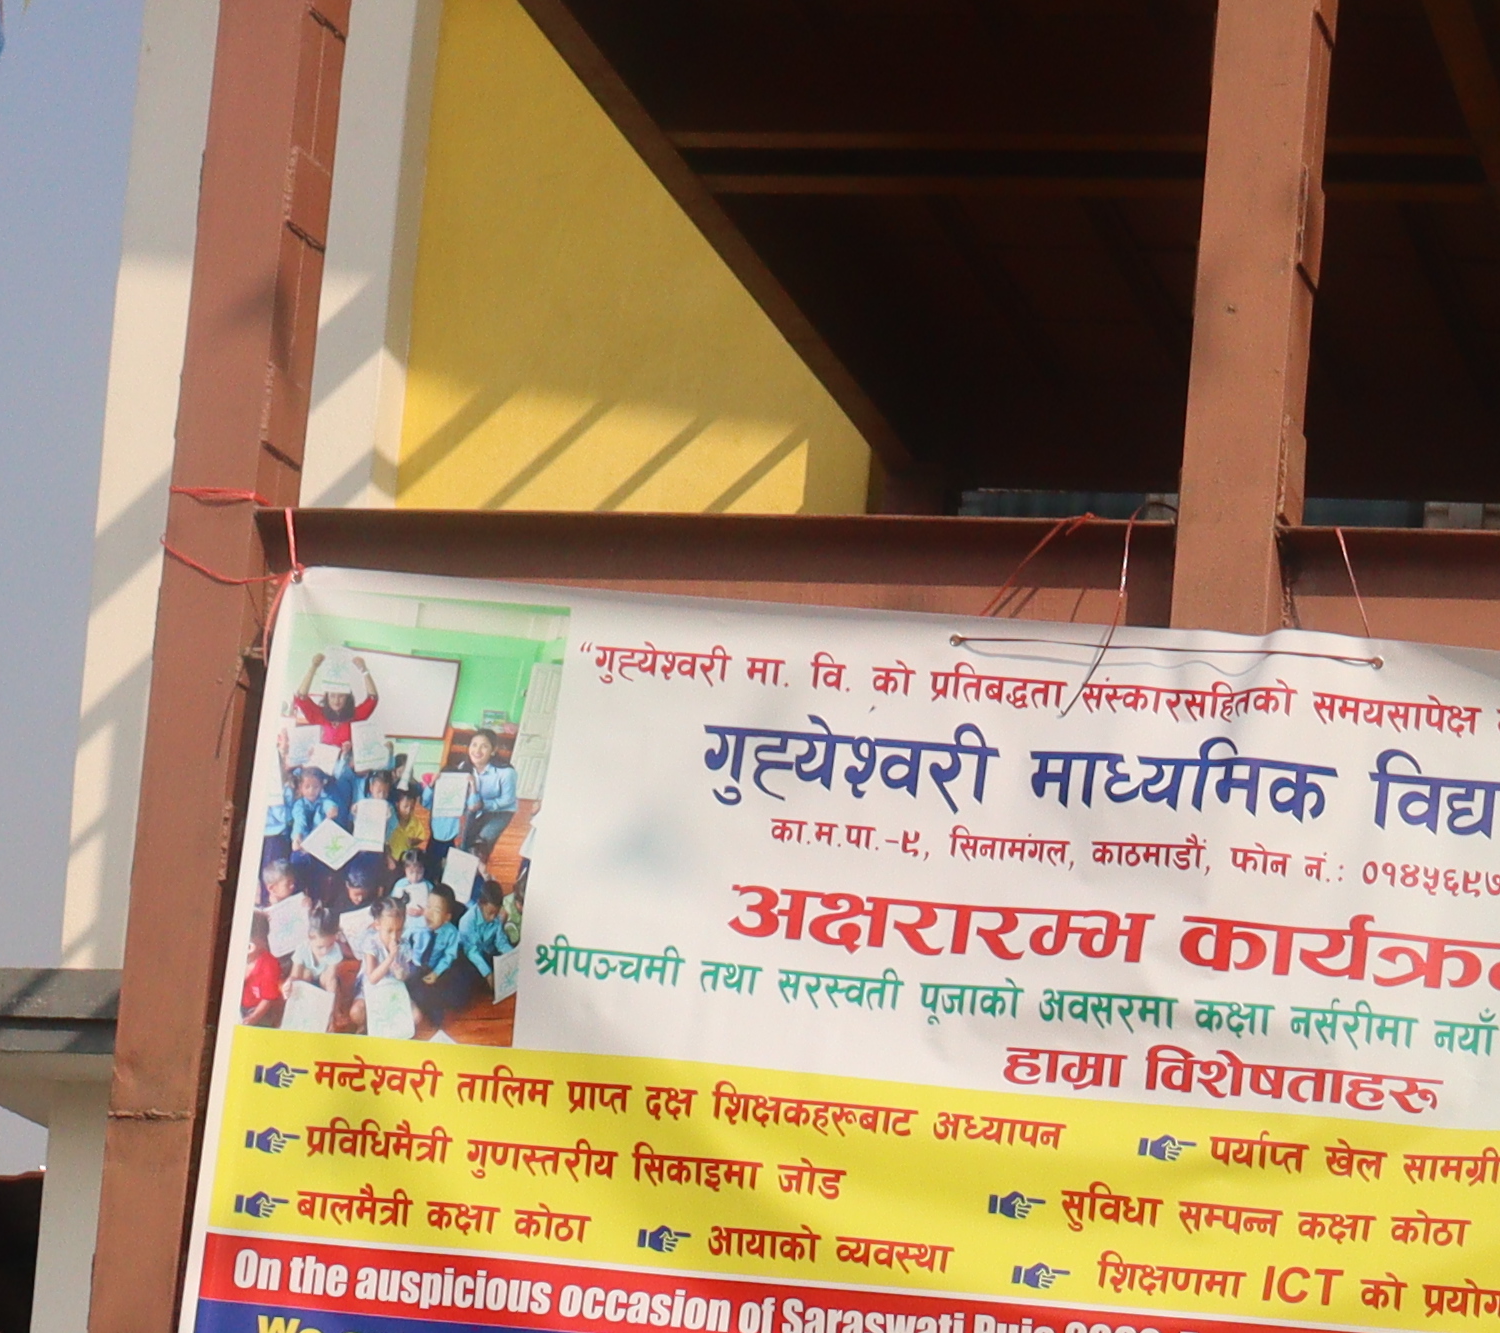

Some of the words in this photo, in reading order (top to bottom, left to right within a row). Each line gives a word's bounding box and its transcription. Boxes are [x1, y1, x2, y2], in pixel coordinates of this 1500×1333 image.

[746, 656, 789, 687] मा.
[810, 650, 851, 692] वि.
[871, 659, 917, 695] को
[1312, 691, 1483, 737] समयसापेक्ष
[705, 716, 998, 812] गुह्येश्वरी
[1032, 738, 1337, 820] माध्यमिक
[949, 824, 1075, 866] सिनामंगल,
[1091, 833, 1212, 872] काठमाडौं,
[1229, 842, 1293, 876] फोन
[728, 884, 1156, 963] अक्षरारम्भ
[535, 934, 686, 986] श्रीपञ्चमी
[700, 961, 764, 993] तथा
[778, 968, 905, 1009] सरस्वती
[920, 978, 1025, 1025] पूजाको
[1040, 989, 1178, 1028] अवसरमा
[1195, 1000, 1276, 1036] कक्षा
[1290, 999, 1419, 1047] नर्सरीमा
[1434, 1009, 1499, 1055] नयाँ
[314, 1054, 444, 1100] मन्टेश्वरी
[457, 1063, 555, 1106] तालिम
[566, 1080, 633, 1112] प्राप्त
[645, 1085, 699, 1120] दक्ष
[934, 1111, 1067, 1148] अध्यापन
[1004, 1046, 1128, 1090] हाम्रा
[306, 1116, 454, 1162] प्रविधिमैत्री
[467, 1138, 620, 1181] गुणस्तरीय
[631, 1141, 764, 1192] सिकाइमा
[777, 1157, 847, 1200] जोड
[1210, 1130, 1310, 1172] पर्याप्त
[1324, 1138, 1388, 1181] खेल
[297, 1183, 414, 1225] बालमैत्री
[426, 1200, 501, 1234] कक्षा
[514, 1202, 592, 1242] कोठा
[708, 1224, 822, 1261] आयाको
[835, 1235, 955, 1272] व्यवस्था
[1061, 1180, 1164, 1232] सुविधा
[1179, 1200, 1284, 1236] सम्पन्न
[1298, 1211, 1377, 1243] कक्षा
[1391, 1209, 1473, 1247] कोठा
[233, 1248, 282, 1291] On
[288, 1255, 349, 1298] the
[354, 1266, 553, 1315] auspicious
[558, 1284, 731, 1333] occasion
[1098, 1250, 1247, 1297] शिक्षणमा
[1262, 1265, 1345, 1305] ICT
[1360, 1271, 1409, 1310] को
